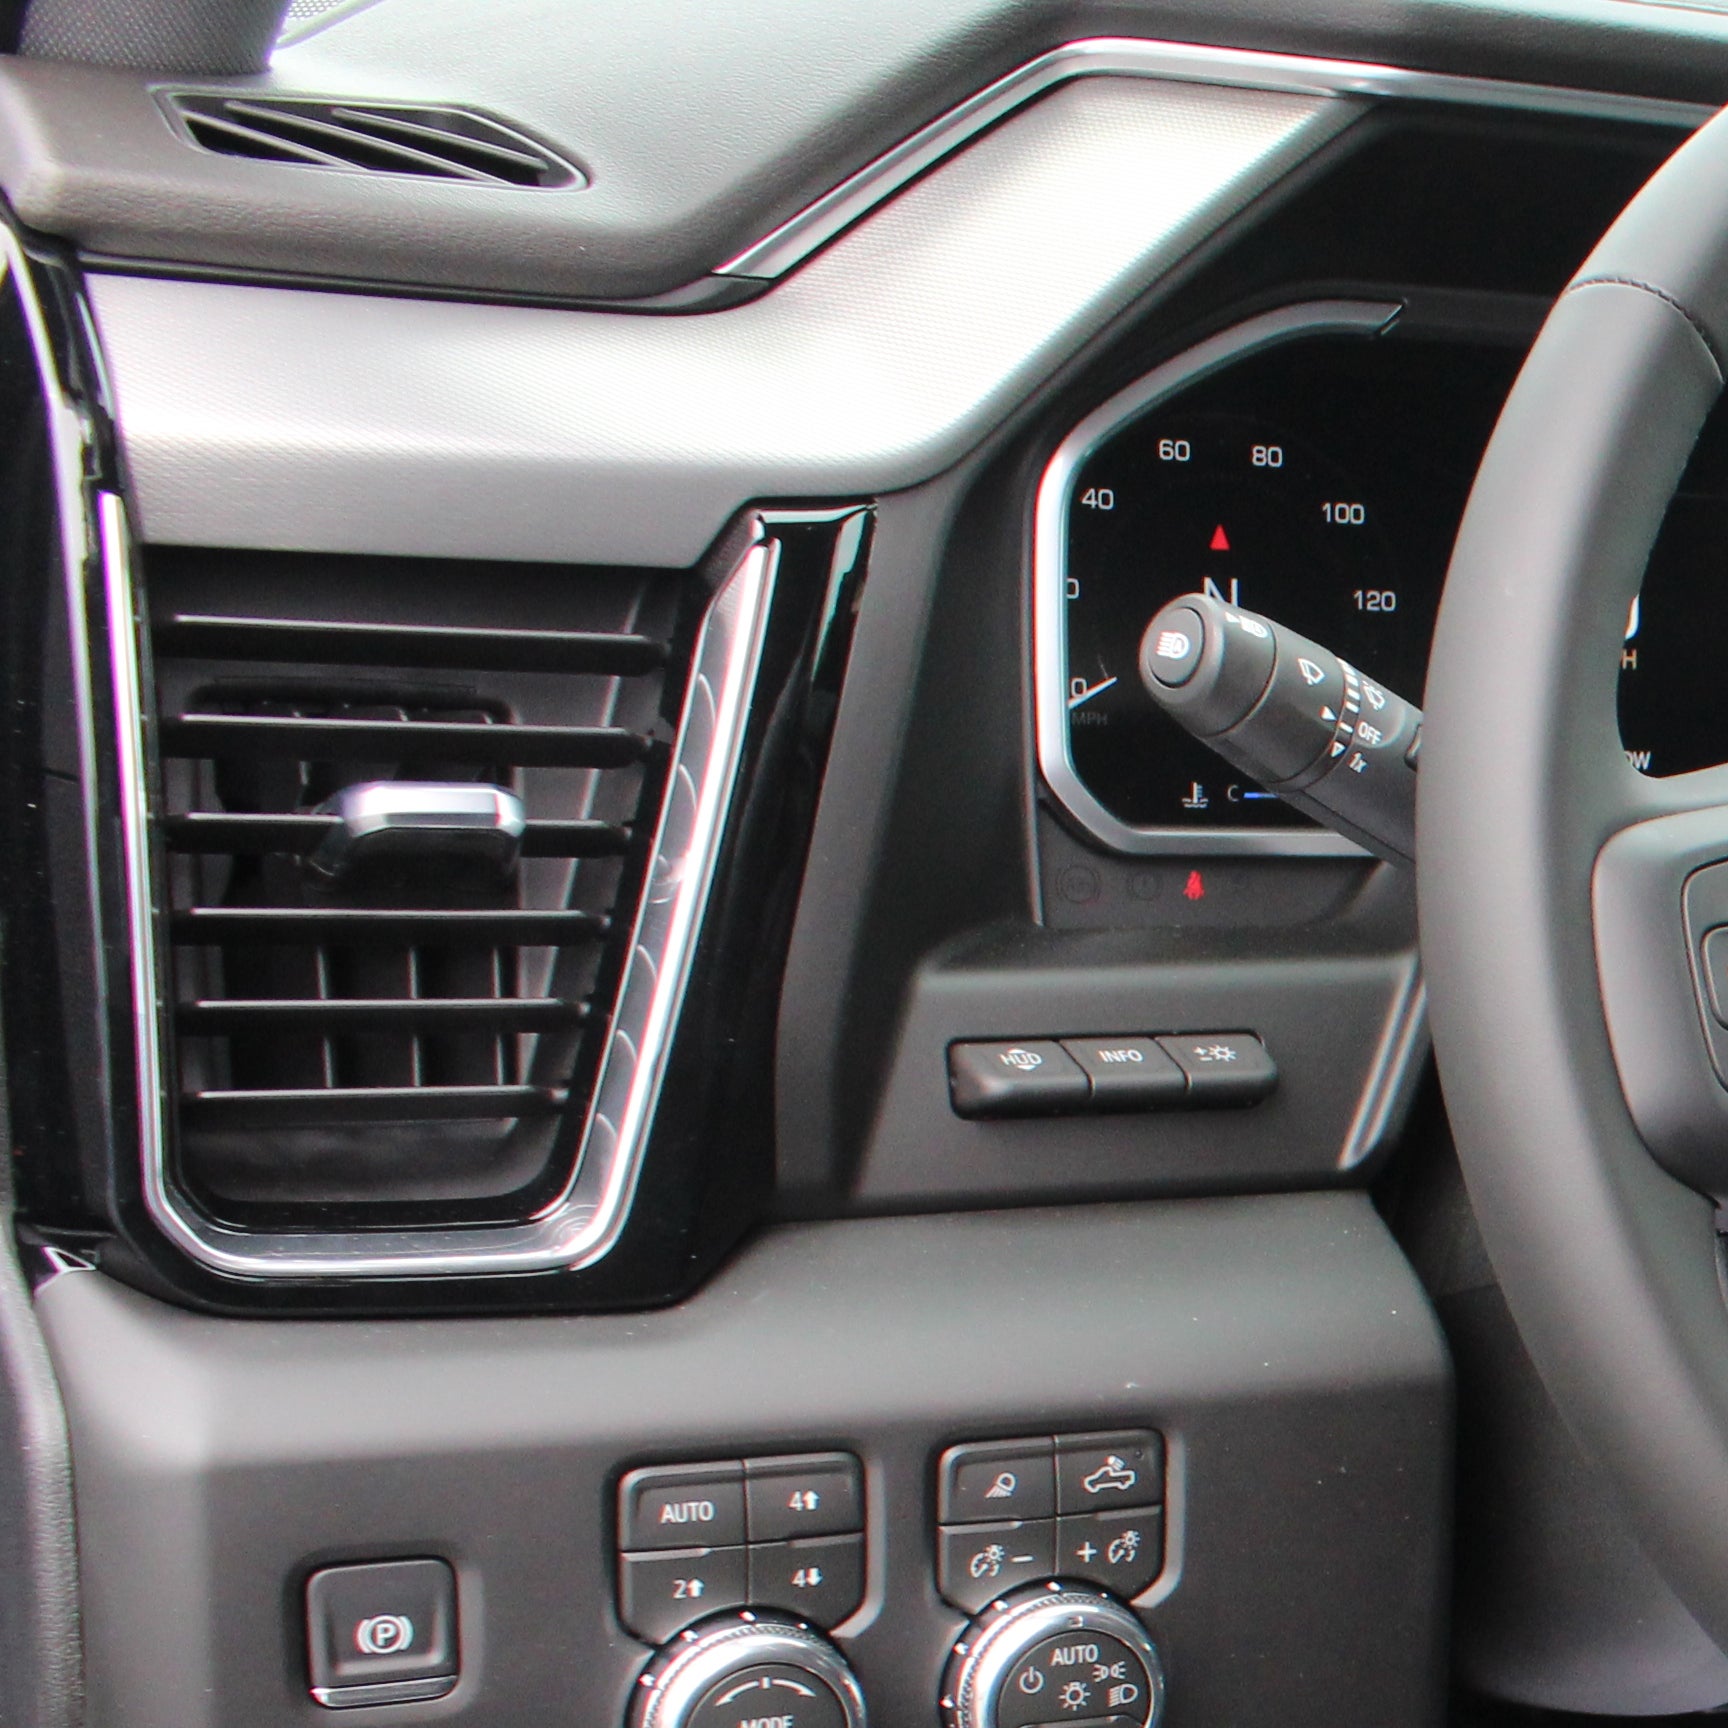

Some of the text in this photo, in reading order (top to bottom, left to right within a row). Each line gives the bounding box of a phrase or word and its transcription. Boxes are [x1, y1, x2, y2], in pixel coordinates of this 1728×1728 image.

[1158, 440, 1191, 462] 60
[1252, 446, 1284, 468] 80
[1082, 489, 1115, 510] 40
[1322, 503, 1365, 525] 100
[1202, 576, 1239, 607] N
[1354, 590, 1396, 612] 120
[1071, 678, 1087, 698] 0
[1071, 712, 1108, 726] MPH
[1358, 721, 1383, 745] OFF
[1349, 752, 1368, 774] 1x
[1227, 785, 1240, 801] C
[1000, 1051, 1043, 1067] HUD
[1099, 1049, 1144, 1063] INFO
[660, 1501, 715, 1524] AUTO
[1051, 1644, 1098, 1666] AUTO
